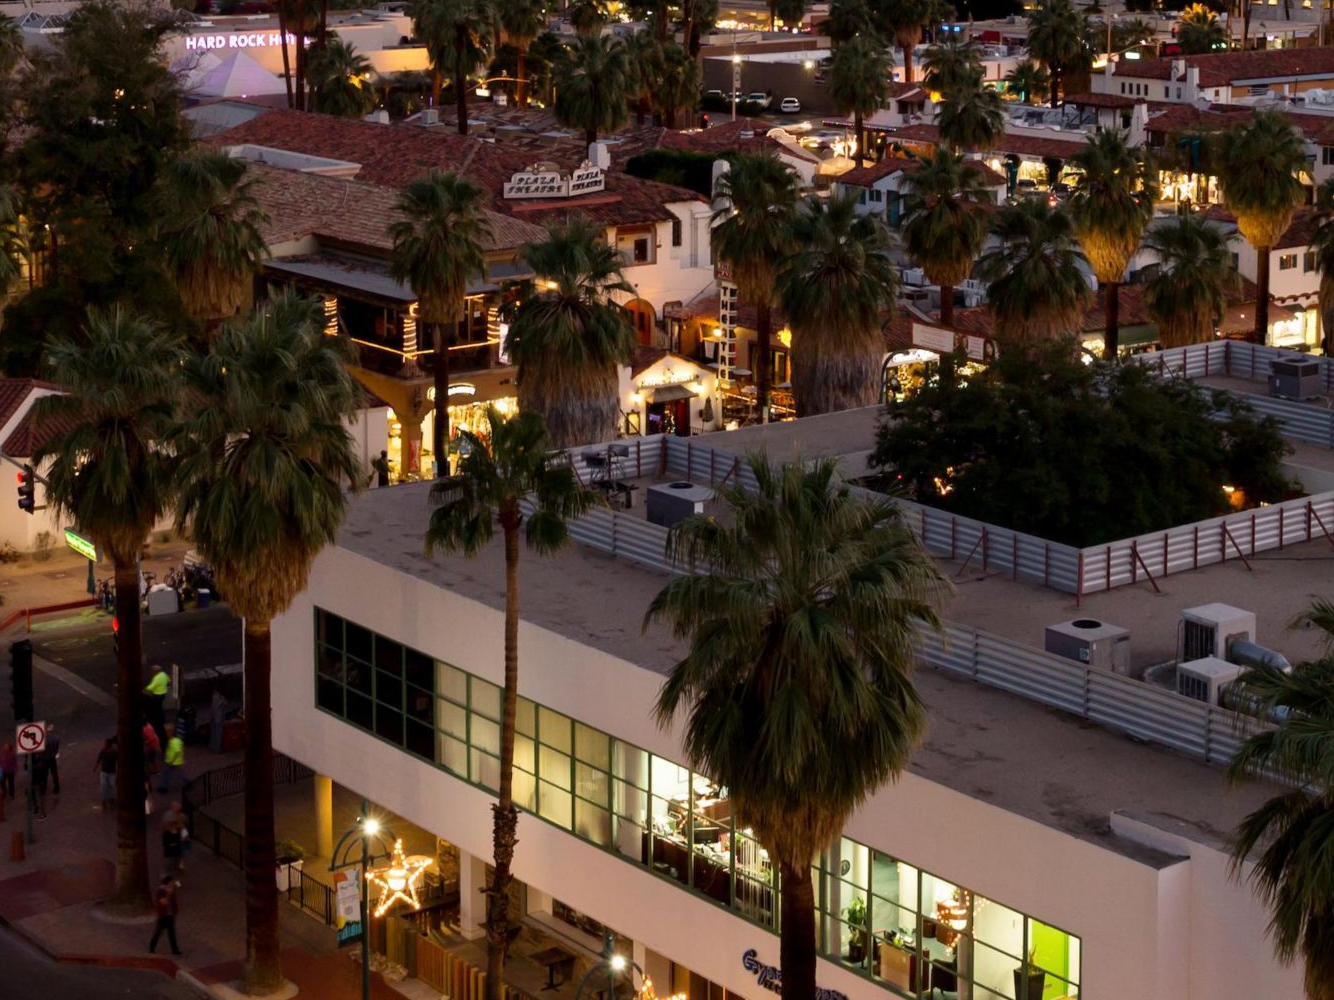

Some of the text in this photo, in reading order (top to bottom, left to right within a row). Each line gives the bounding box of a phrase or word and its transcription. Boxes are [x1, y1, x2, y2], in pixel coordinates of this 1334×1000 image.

[186, 33, 311, 49] HARD ROCK HTL
[517, 176, 555, 186] PLAZA
[577, 171, 598, 181] PLAZA
[508, 184, 563, 194] THEATRE
[571, 180, 603, 192] THEATRE
